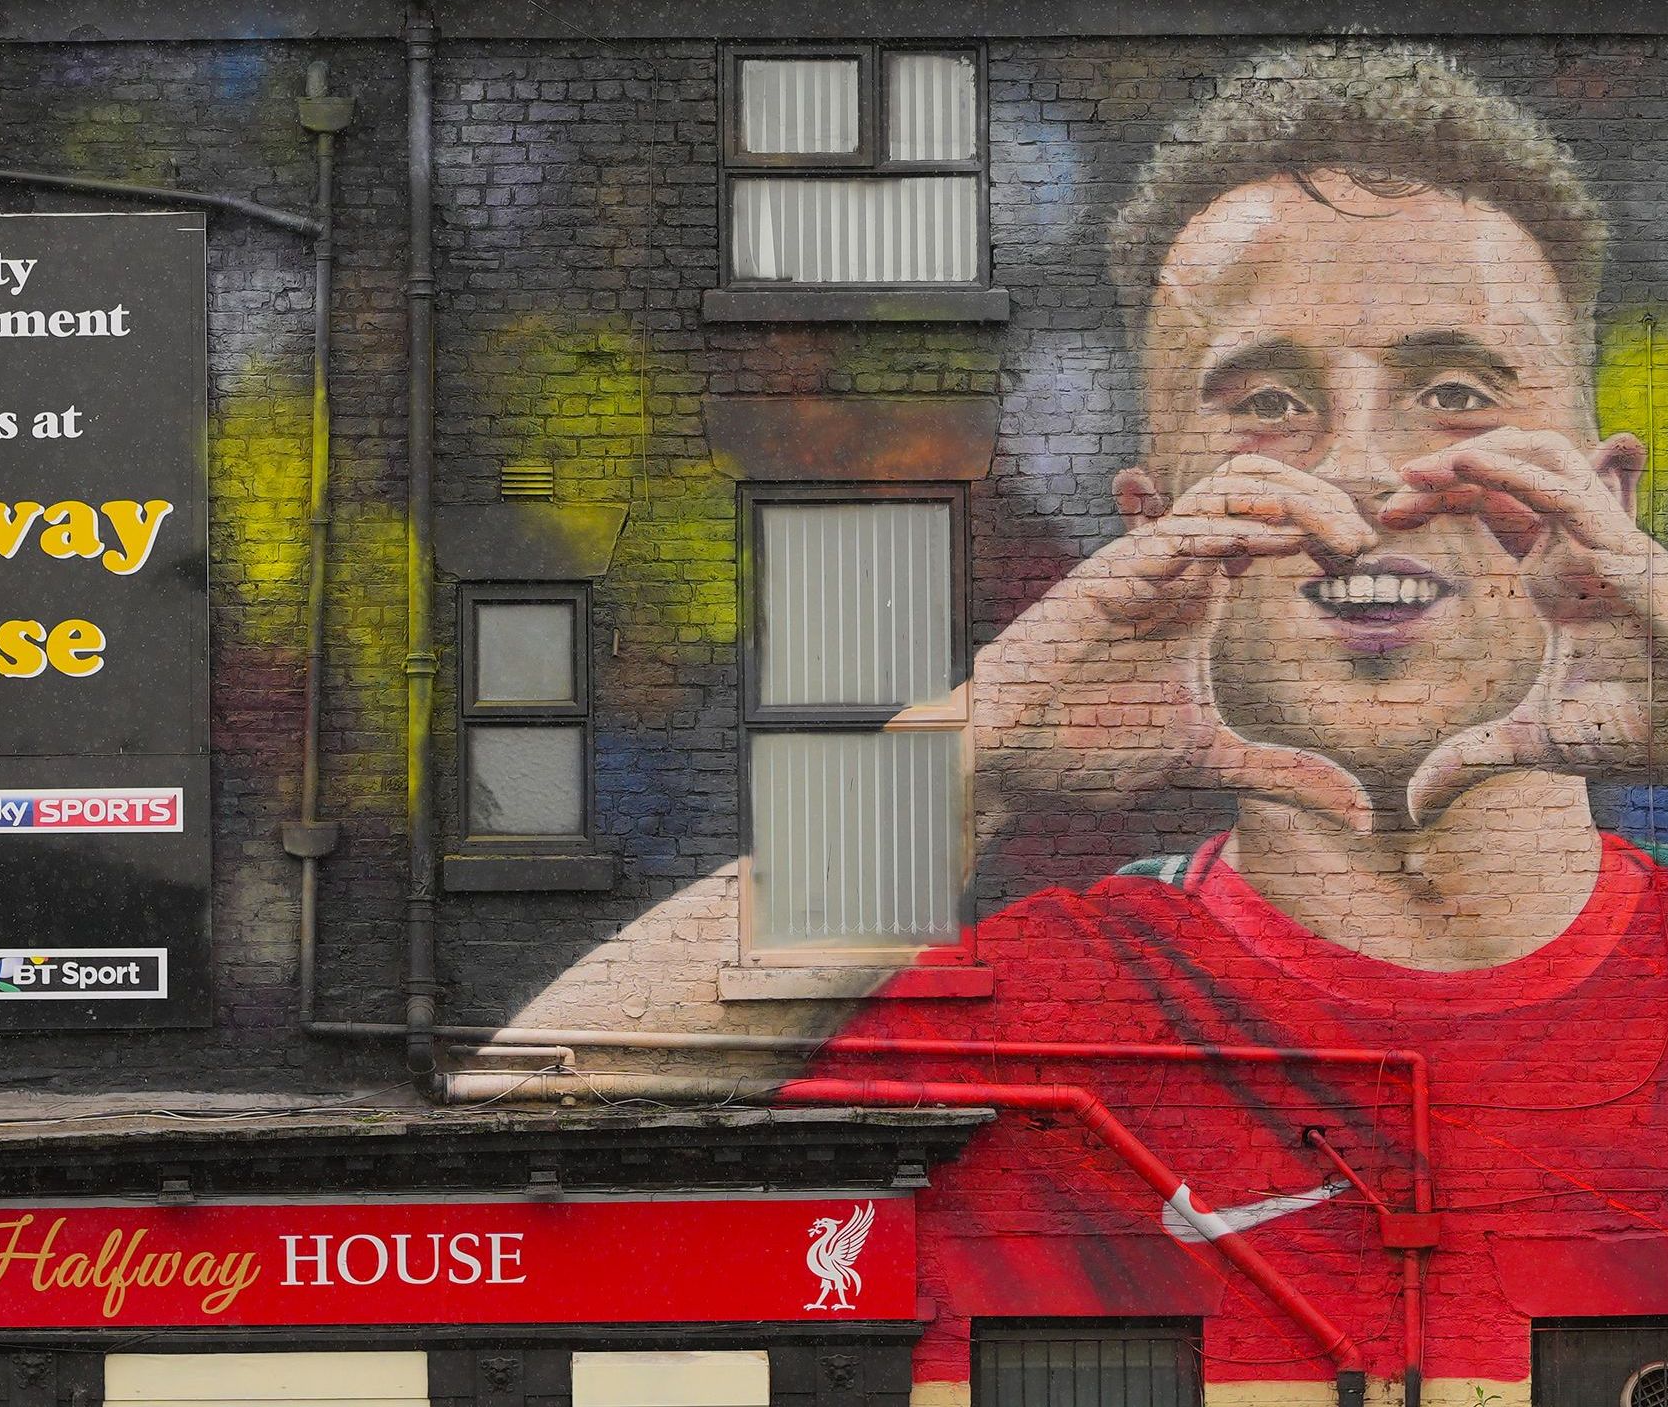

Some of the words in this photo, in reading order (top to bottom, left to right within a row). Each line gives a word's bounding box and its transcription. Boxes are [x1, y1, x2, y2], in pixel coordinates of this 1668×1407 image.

[33, 403, 83, 440] at
[38, 797, 171, 825] SPORTS
[12, 963, 59, 986] BT
[61, 961, 141, 989] Sport
[278, 1231, 528, 1287] HOUSE
